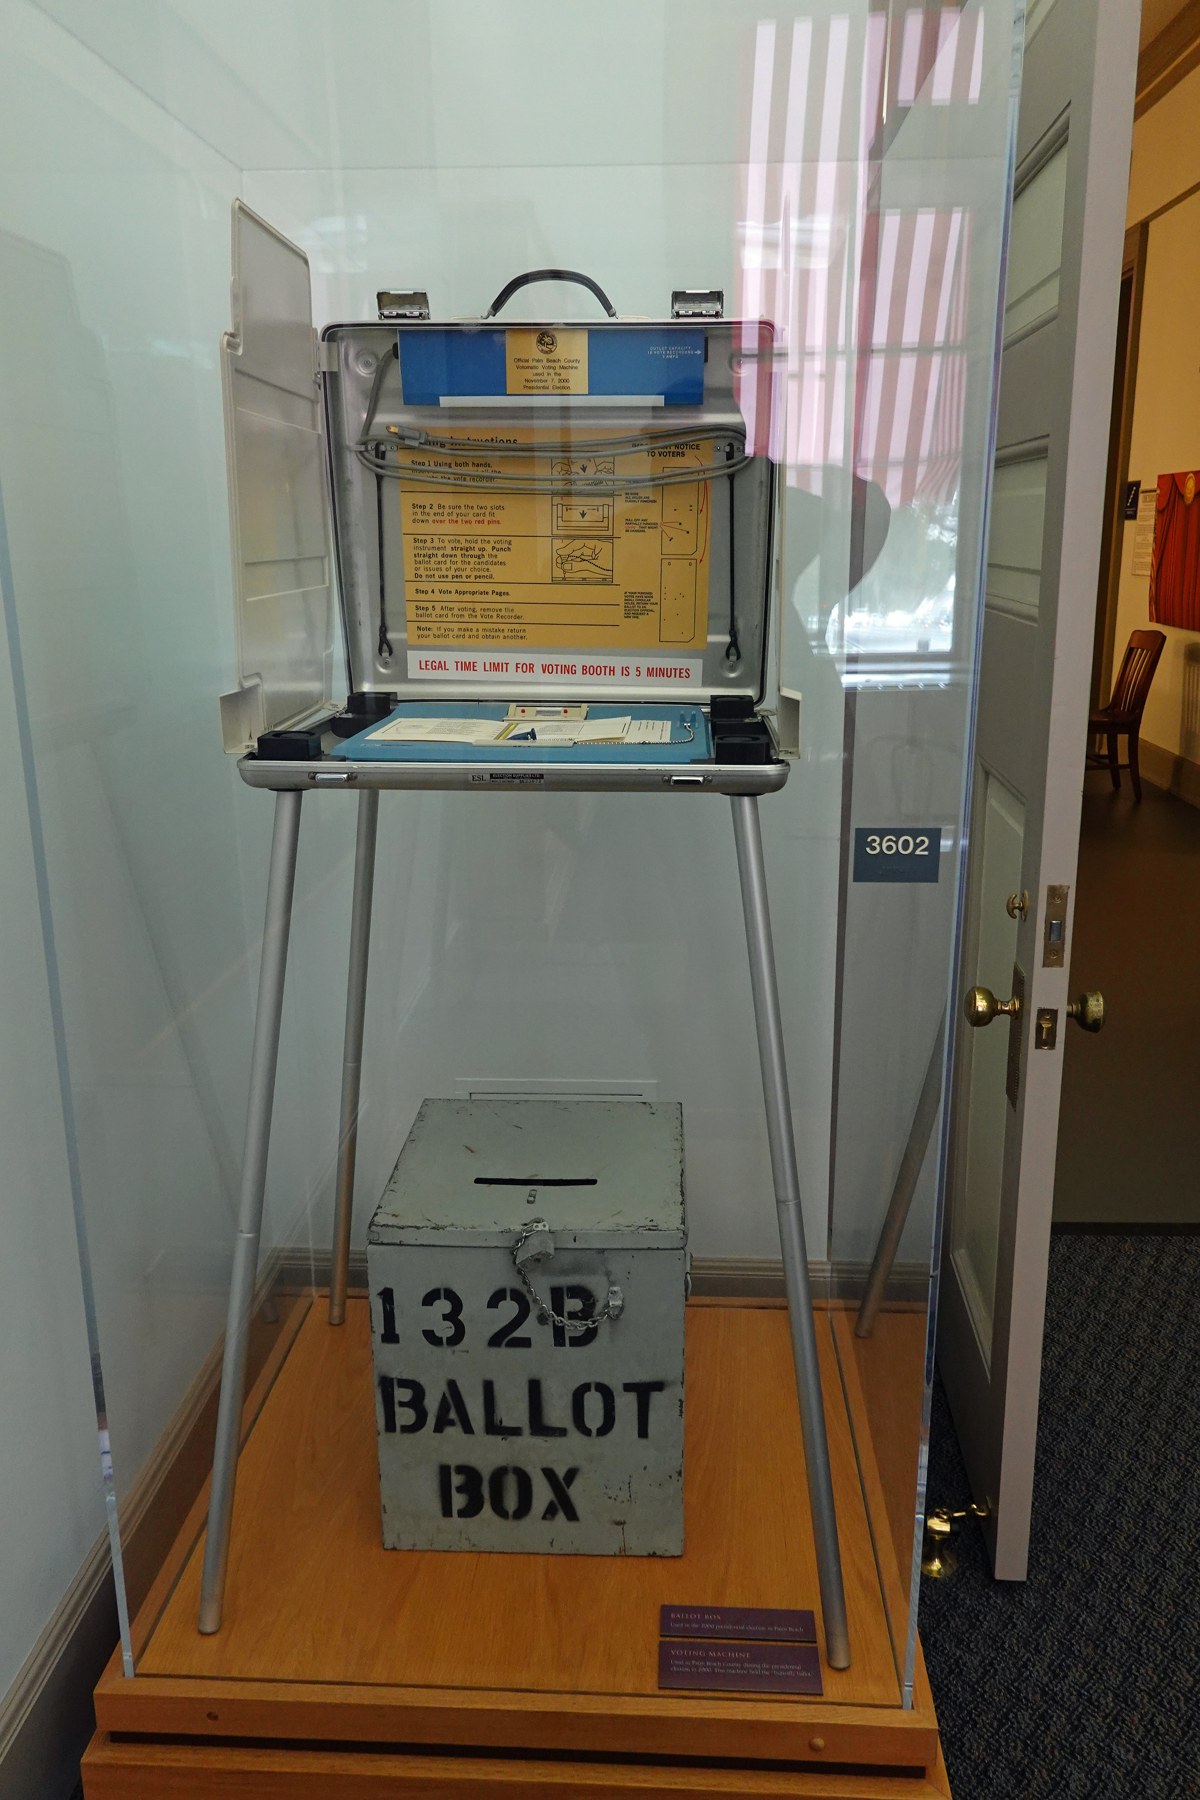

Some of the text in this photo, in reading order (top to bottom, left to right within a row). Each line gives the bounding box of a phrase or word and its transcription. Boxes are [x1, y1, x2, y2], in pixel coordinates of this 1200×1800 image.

[419, 660, 691, 679] LEGAL TIME LIMIT FOR VOTING BOOTH IS 5 MINUTES
[866, 836, 929, 855] 3602
[378, 1375, 667, 1439] BALLOT
[439, 1463, 580, 1522] BOX
